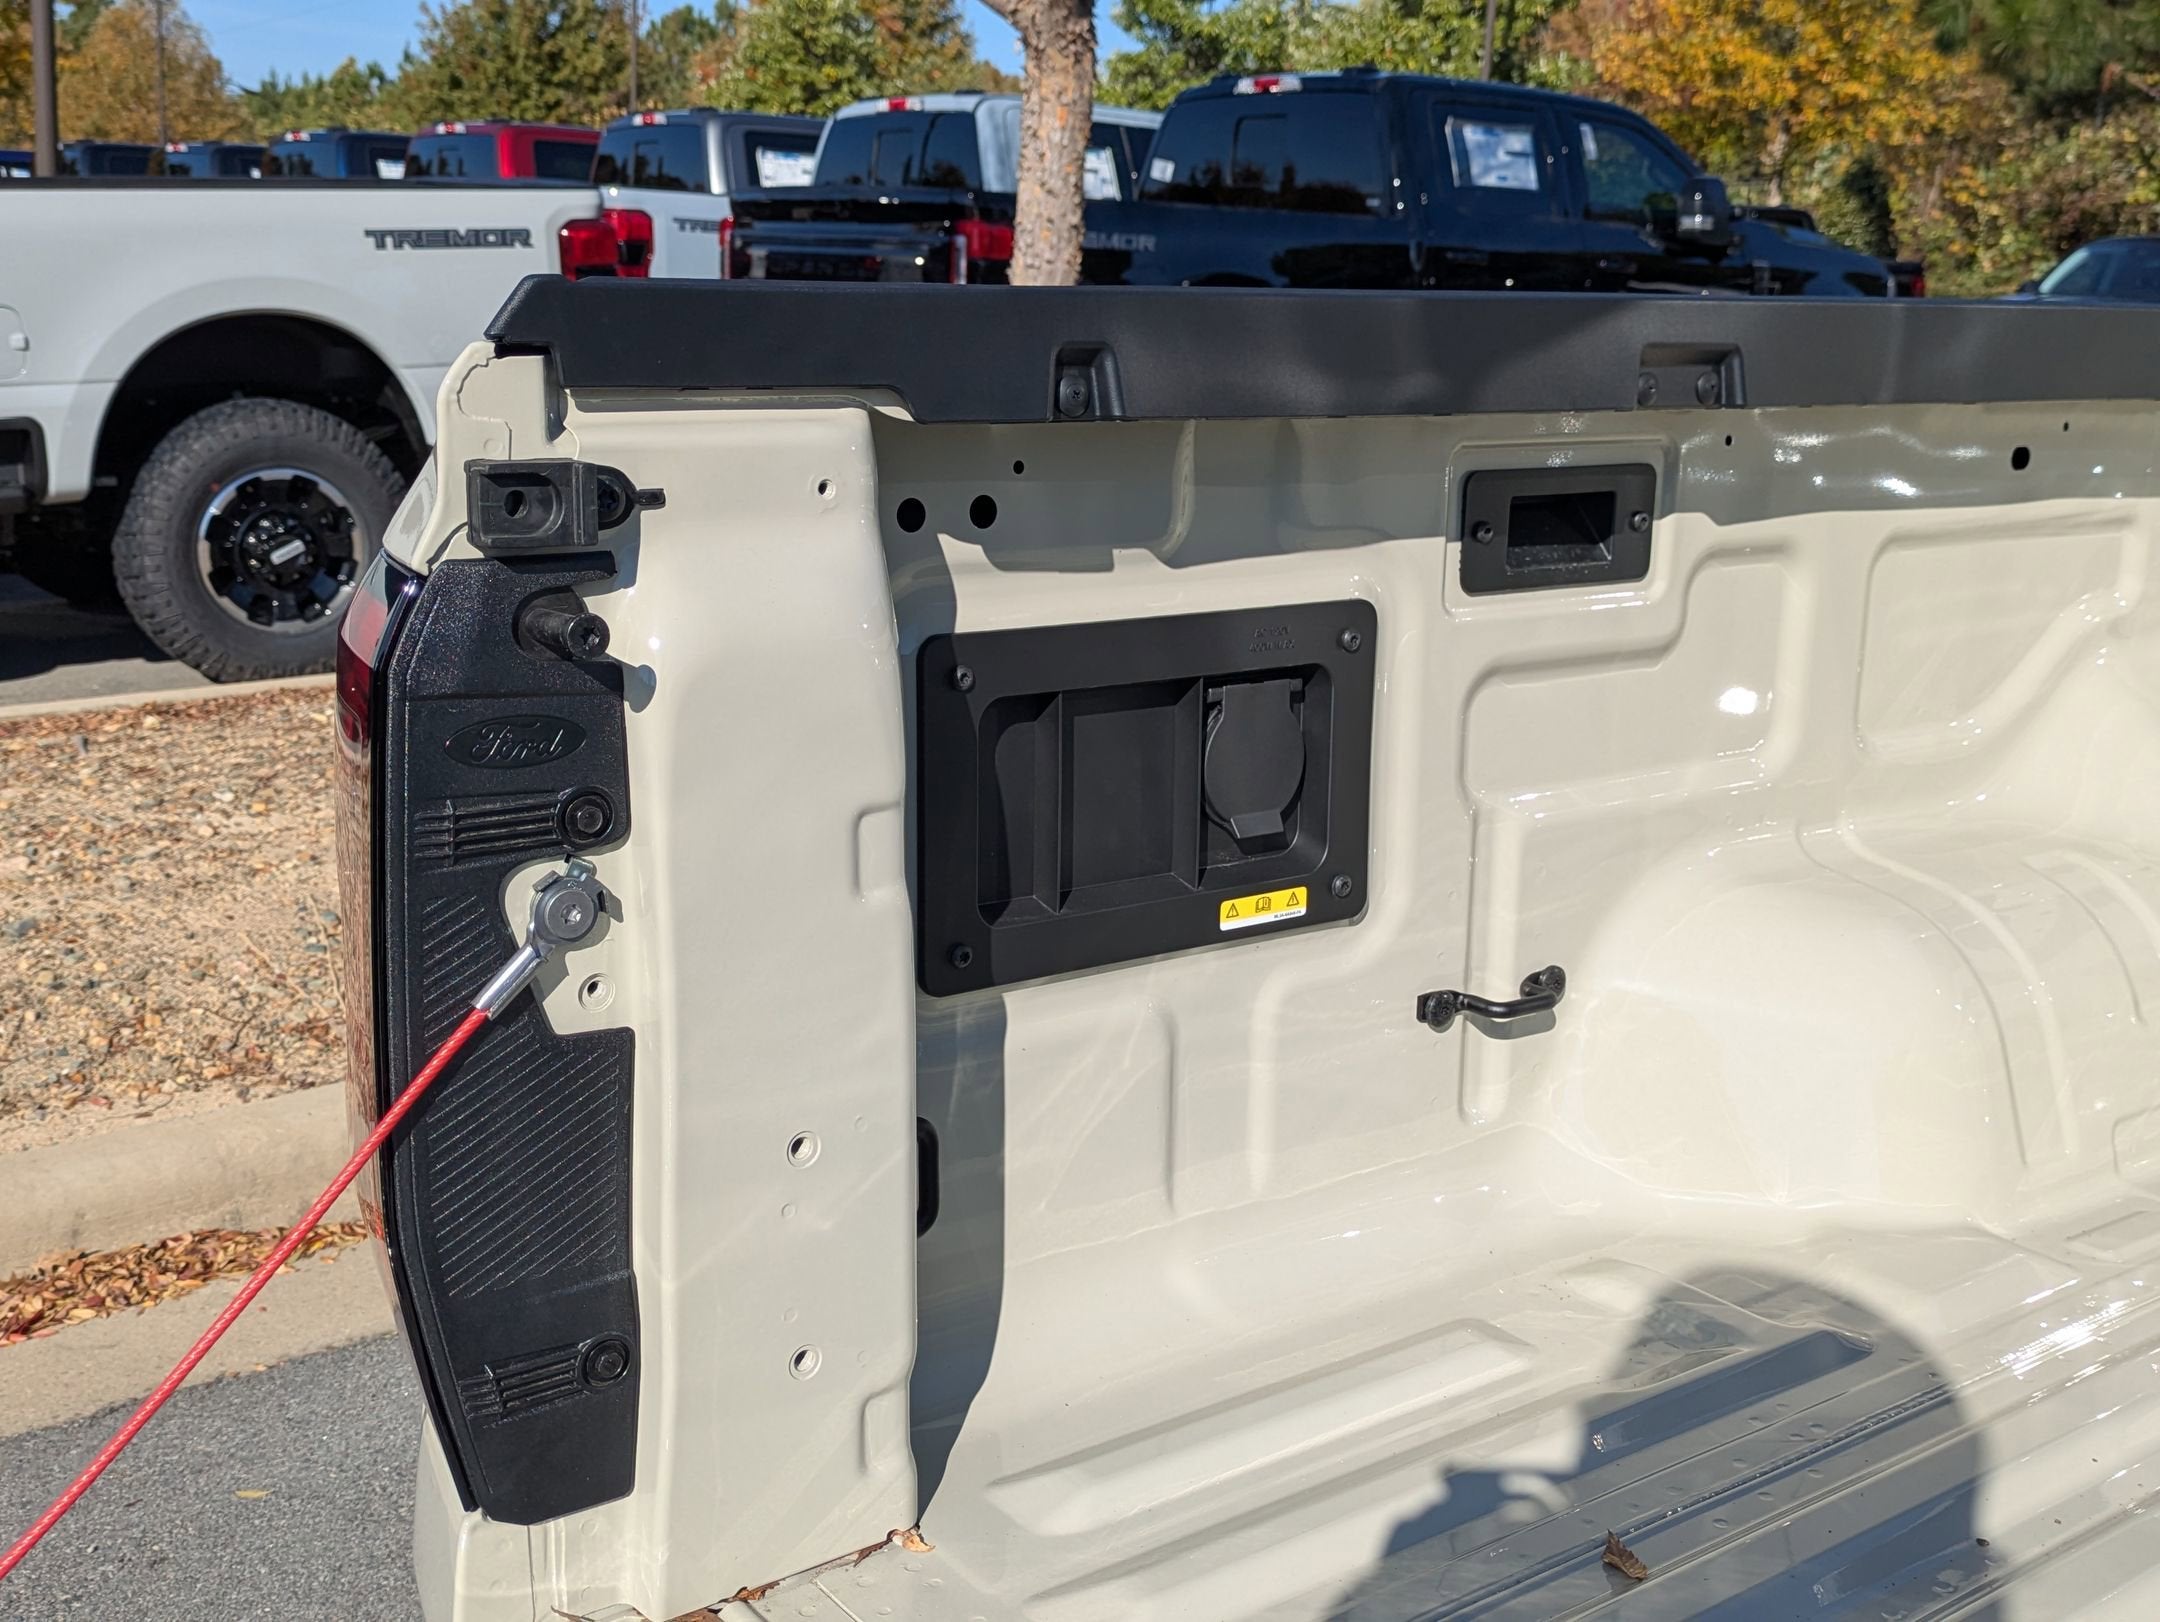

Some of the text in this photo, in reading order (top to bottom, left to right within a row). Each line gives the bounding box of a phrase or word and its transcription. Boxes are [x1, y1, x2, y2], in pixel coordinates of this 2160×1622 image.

[672, 217, 721, 233] TRE
[364, 229, 535, 251] TREMOR
[1083, 230, 1157, 252] EMOR
[470, 722, 564, 765] Ford
